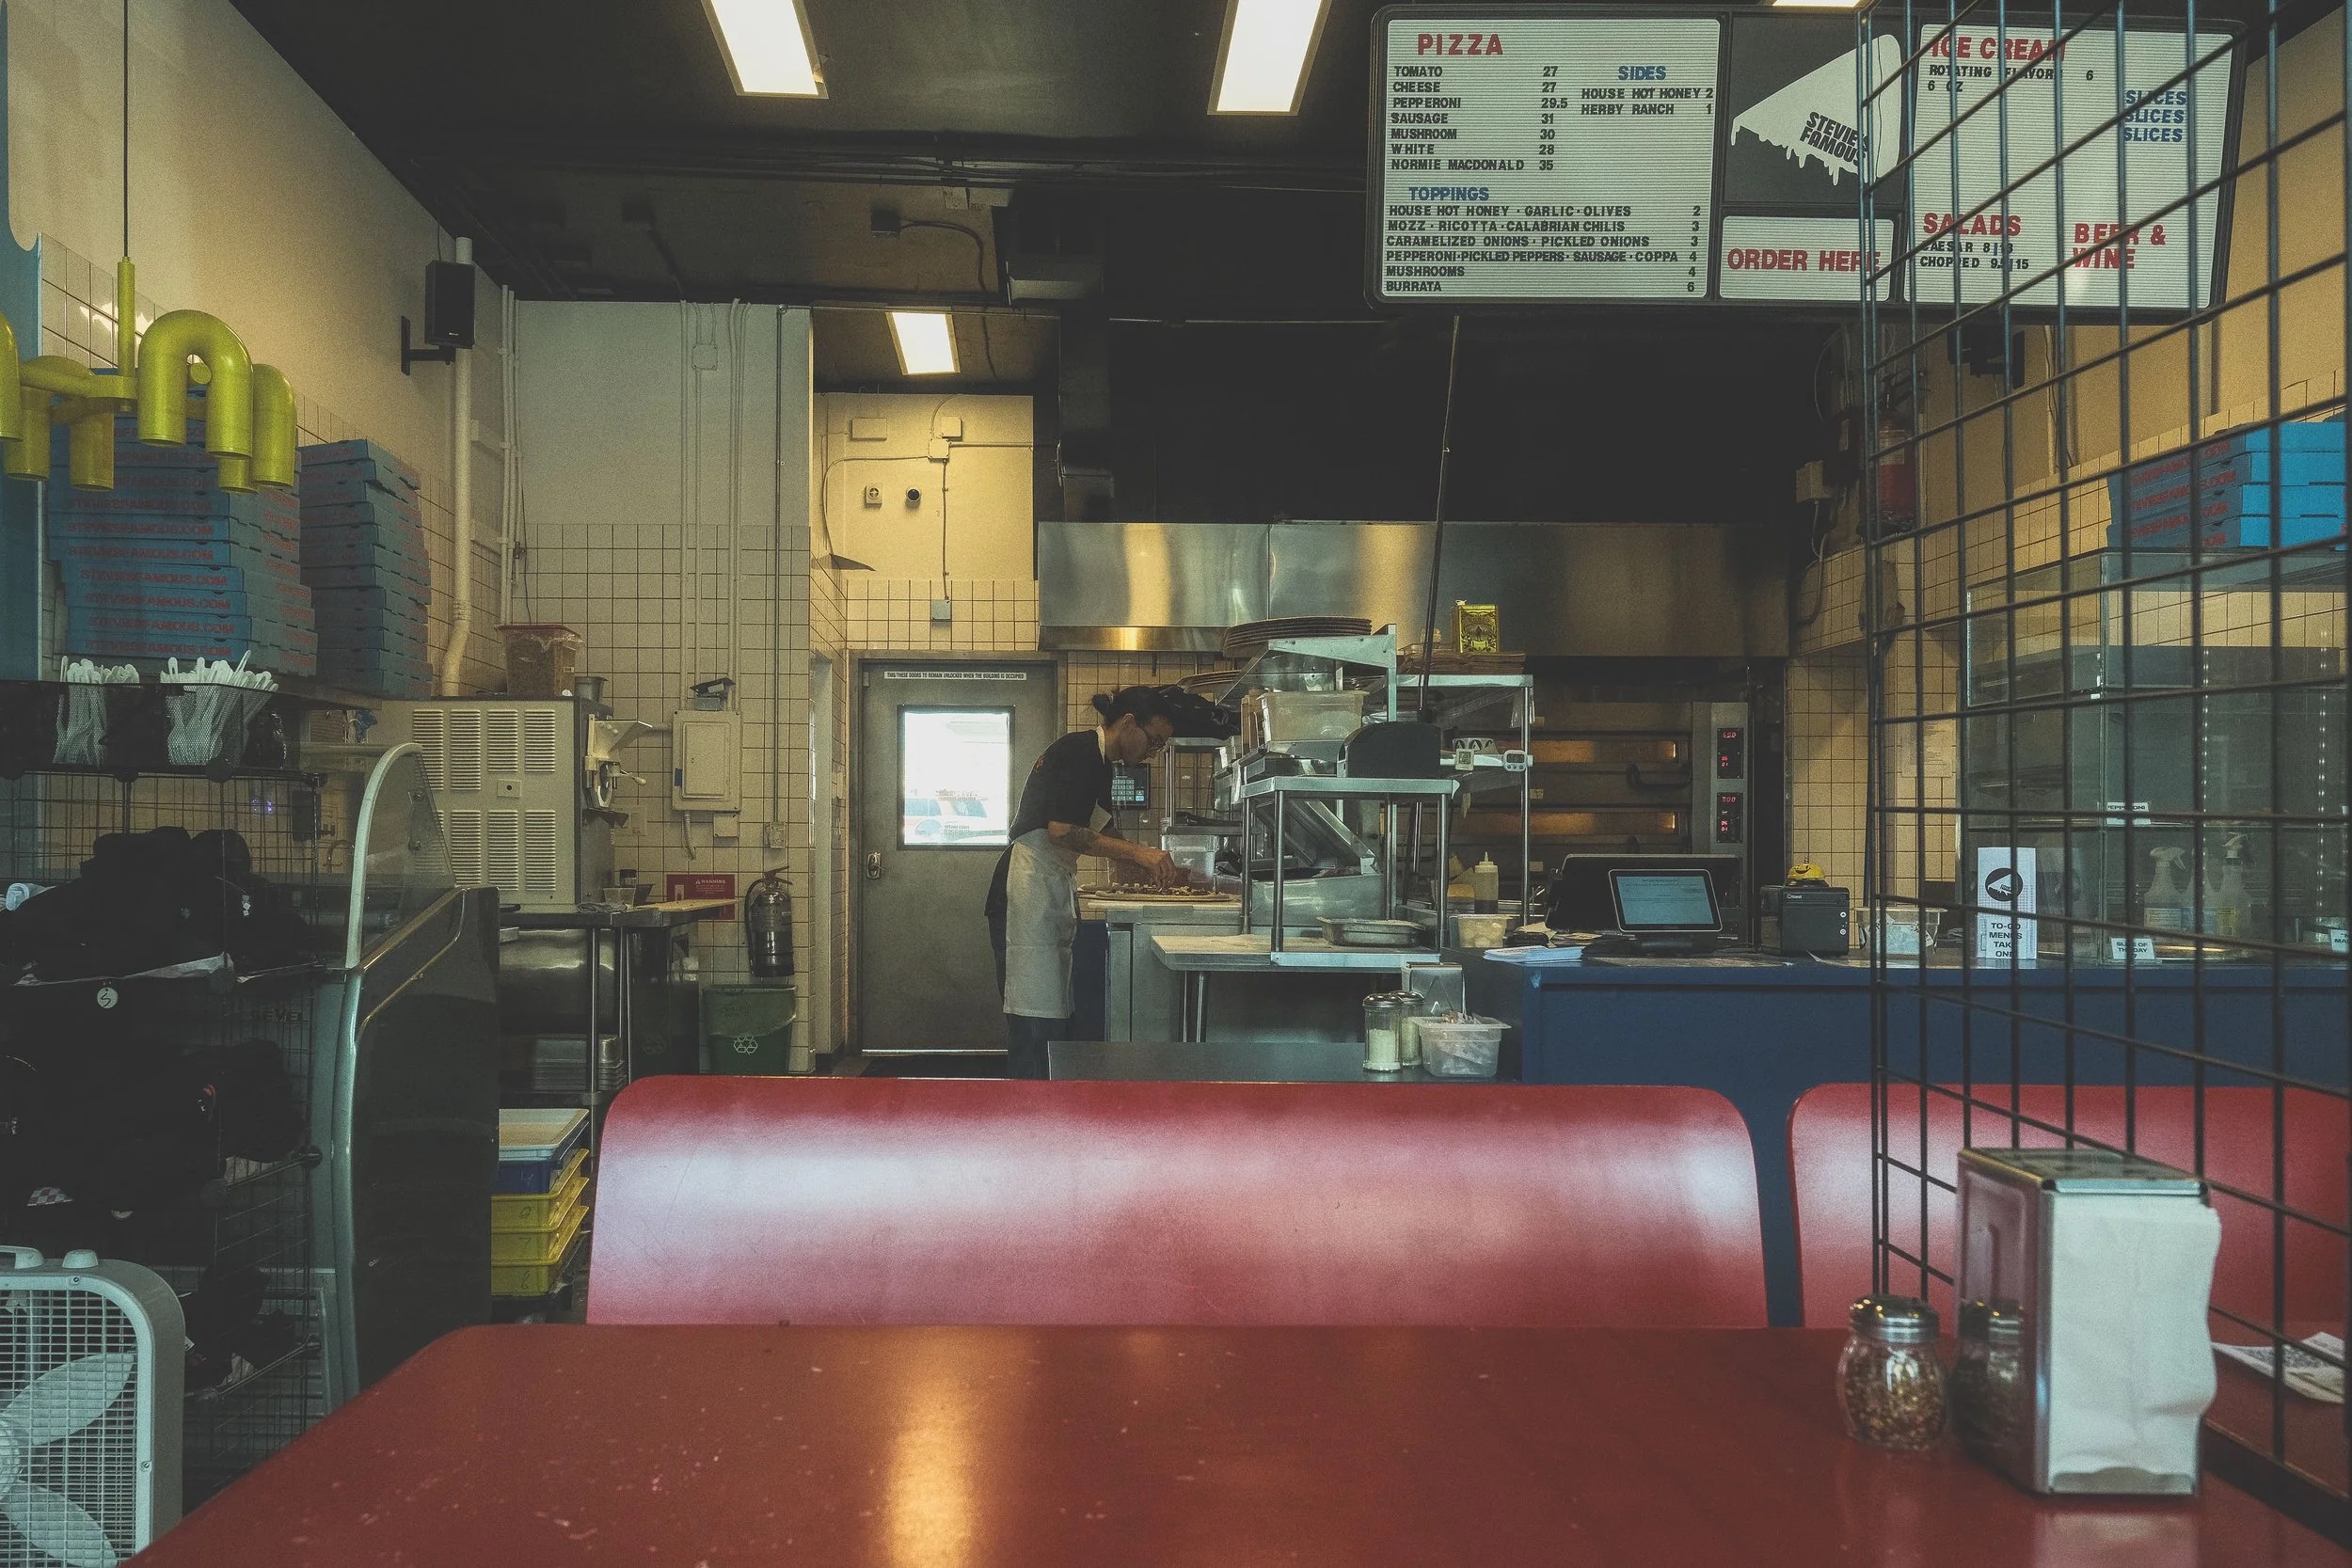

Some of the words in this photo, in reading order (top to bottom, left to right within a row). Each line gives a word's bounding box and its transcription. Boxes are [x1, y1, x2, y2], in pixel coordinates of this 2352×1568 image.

[1418, 34, 1503, 55] PIZZA
[1394, 66, 1442, 77] TOMATO
[1543, 67, 1558, 77] 27
[1618, 66, 1666, 80] SIDES
[2005, 67, 2063, 80] FAVOR
[2086, 70, 2094, 81] 6
[1393, 82, 1440, 92] CHEESE
[1542, 83, 1557, 93] 27
[1928, 80, 1935, 91] 6
[1581, 87, 1625, 99] HOUSE
[1632, 87, 1654, 99] HOT
[1659, 87, 1701, 100] HONEY
[1705, 87, 1713, 99] 2
[2126, 90, 2187, 105] SLCES
[1393, 97, 1461, 109] PEPPERONI
[1541, 98, 1567, 109] 29.5
[1581, 103, 1623, 115] HERBY
[1631, 103, 1674, 115] RANCH
[1706, 103, 1712, 114] 1
[1391, 113, 1448, 124] SAUSAGE
[1541, 114, 1554, 124] 31
[2124, 109, 2184, 123] SLICES
[1391, 129, 1457, 139] MUSHROOM
[1540, 129, 1555, 139] 30
[2123, 127, 2183, 143] SLICES
[1391, 144, 1435, 154] WHITE
[1539, 145, 1554, 155] 28
[1391, 159, 1441, 170] NORMIE
[1448, 160, 1524, 171] MACDONALD
[1539, 160, 1553, 170] 35
[1409, 187, 1489, 201] TOPPINGS
[1390, 206, 1431, 216] HOUSE
[1438, 206, 1459, 216] HOT
[1466, 206, 1509, 216] HONEY
[1525, 206, 1574, 216] GARLIC
[1583, 206, 1631, 217] OLIVES
[1692, 206, 1701, 216] 2
[1389, 221, 1425, 231] MOZZ
[1438, 221, 1498, 231] RICOTTA
[1506, 221, 1580, 231] CALABRIAN
[1582, 221, 1626, 231] CHILIS
[1692, 221, 1699, 231] 3
[1923, 213, 2022, 236] SALADS
[2151, 225, 2165, 245] &
[1387, 236, 1475, 246] CARAMELIZED
[1484, 236, 1529, 246] ONIONS
[1541, 236, 1595, 247] PICKLED
[1601, 237, 1649, 247] ONIONS
[1691, 237, 1698, 246] 3
[1387, 251, 1457, 261] PEPPERONI
[1461, 251, 1510, 262] PICKLED
[1513, 251, 1565, 262] PEPPERS
[1573, 251, 1627, 262] SAUSAGE
[1635, 251, 1677, 262] COPPA
[1690, 252, 1697, 262] 4
[1727, 248, 1807, 271] ORDER
[1819, 250, 1881, 271] HERE
[1920, 256, 1980, 268] CHOPED
[2073, 247, 2136, 269] WINE
[1387, 266, 1465, 277] MUSHROOMS
[1688, 266, 1695, 277] 4
[1386, 281, 1441, 292] BURRATA
[1687, 282, 1694, 293] 6
